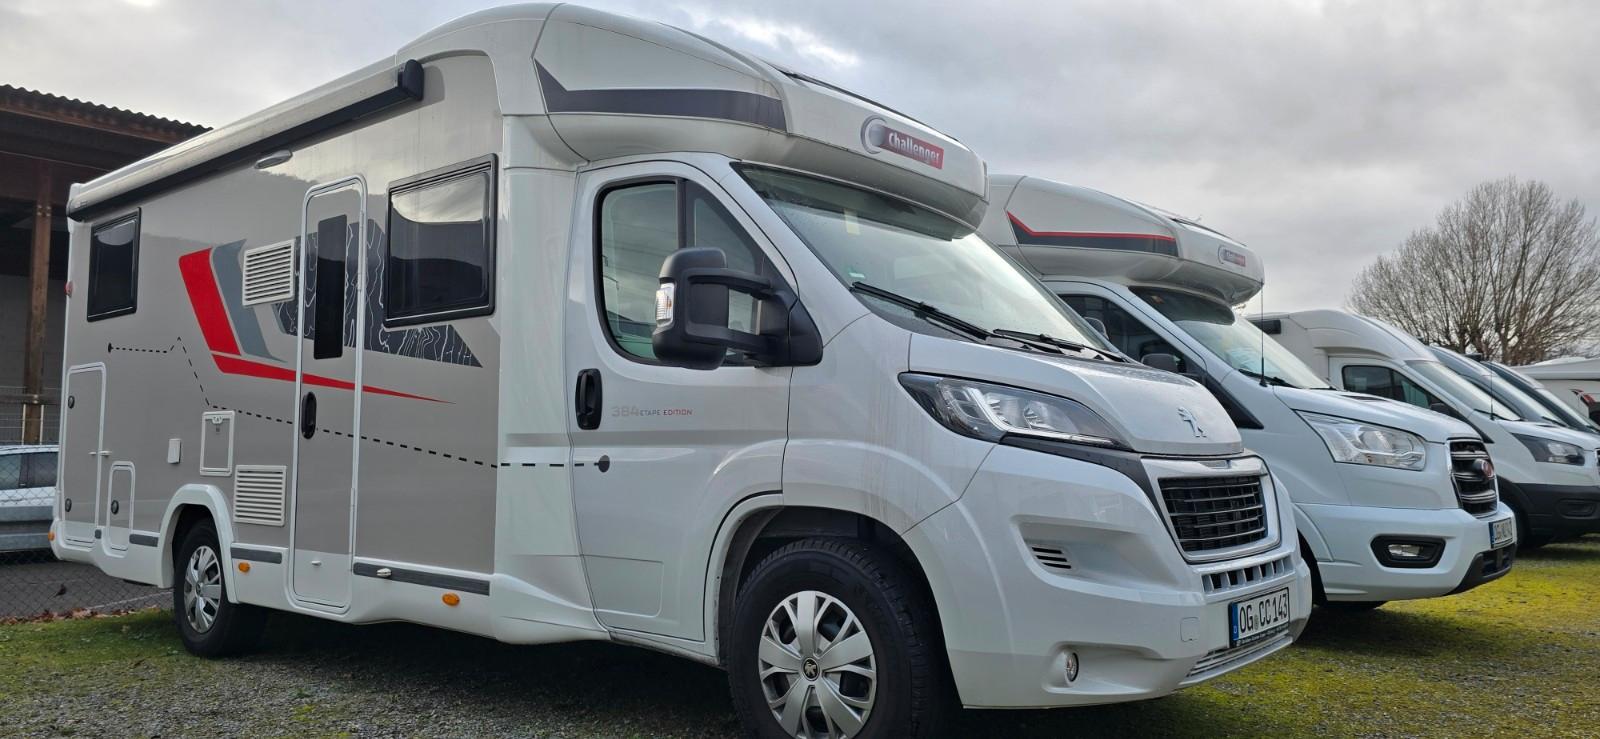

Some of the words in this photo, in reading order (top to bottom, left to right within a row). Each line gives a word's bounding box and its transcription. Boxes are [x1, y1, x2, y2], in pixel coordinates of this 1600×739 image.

[888, 131, 940, 164] Challenger
[611, 405, 639, 417] 384
[639, 409, 661, 417] ETAPE
[663, 408, 693, 417] EDITION
[1239, 604, 1254, 633] OG
[1258, 598, 1272, 627] CC
[1272, 593, 1288, 623] 143
